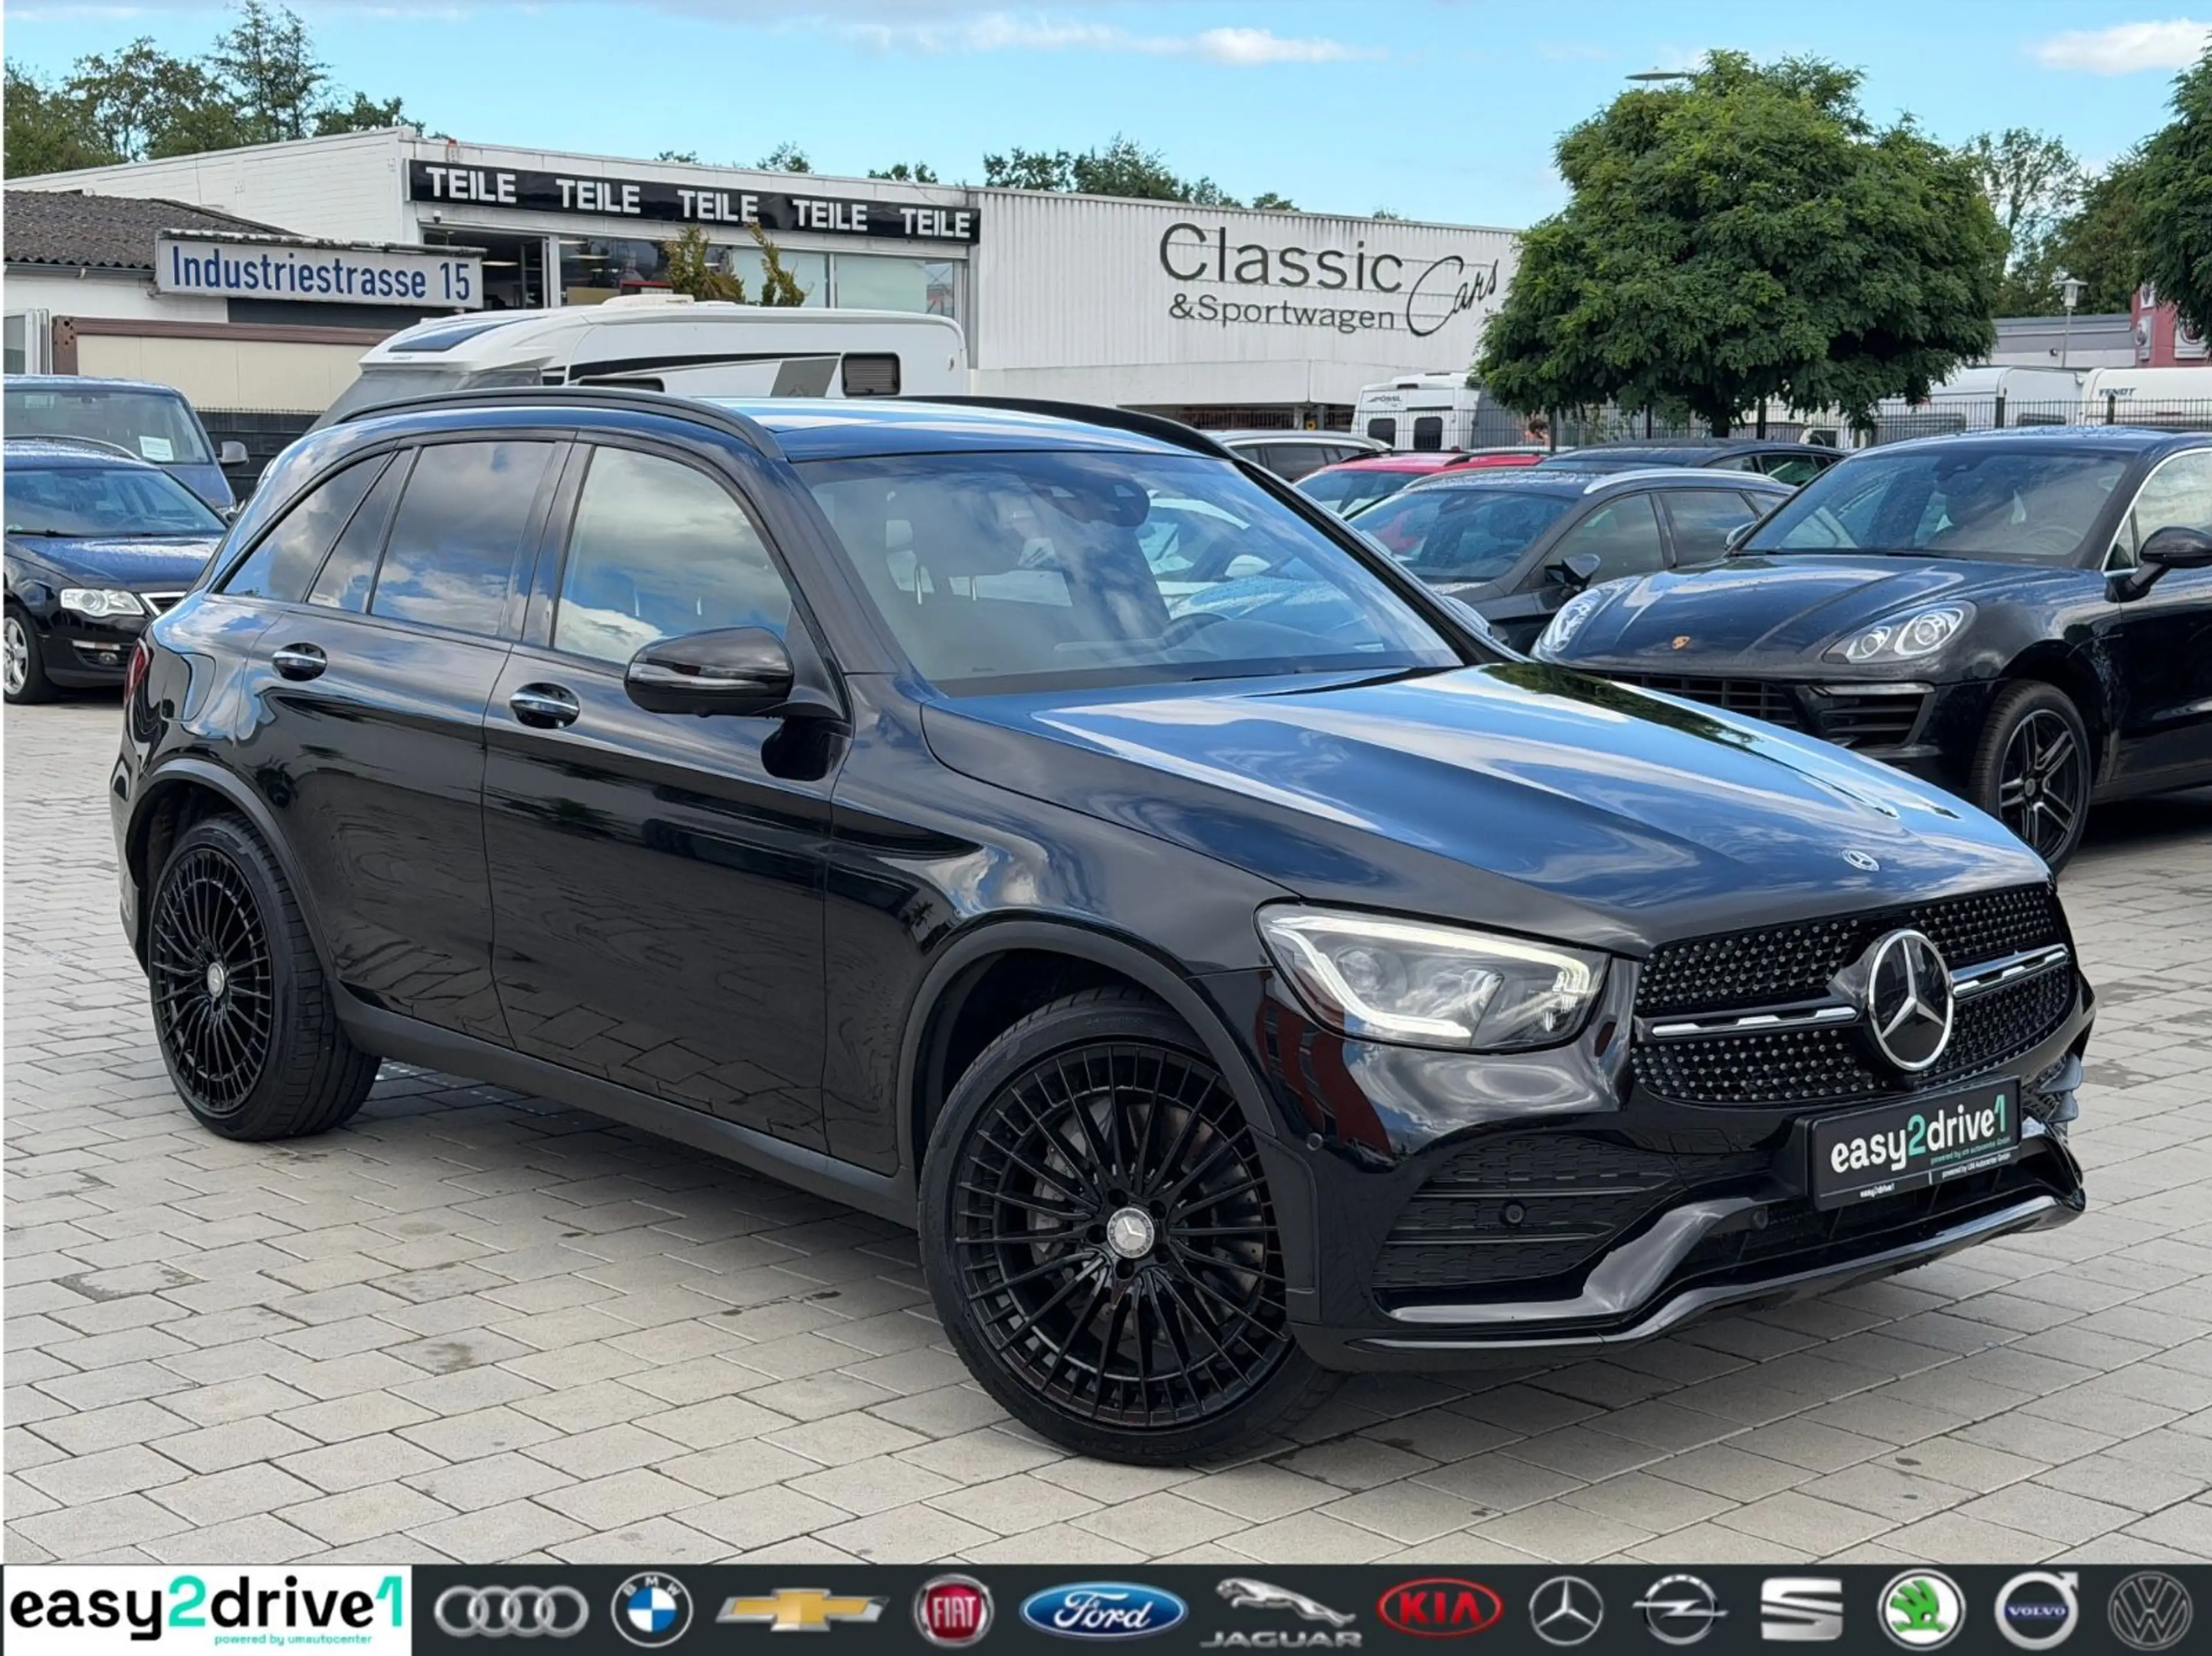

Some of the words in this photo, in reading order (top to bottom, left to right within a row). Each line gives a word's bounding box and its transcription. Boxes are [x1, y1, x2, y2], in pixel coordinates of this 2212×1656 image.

[426, 167, 516, 203] TEILE
[555, 179, 641, 214] TEILE
[678, 190, 758, 222] TEILE
[793, 199, 868, 231] TEILE
[900, 208, 971, 238] TEILE
[173, 246, 426, 300] Industriestrasse
[441, 263, 470, 301] 15
[1159, 222, 1403, 294] Classic
[1406, 255, 1499, 338] Cars
[1169, 293, 1395, 334] &Sportwagen
[1830, 1094, 2006, 1173] easy2drive1
